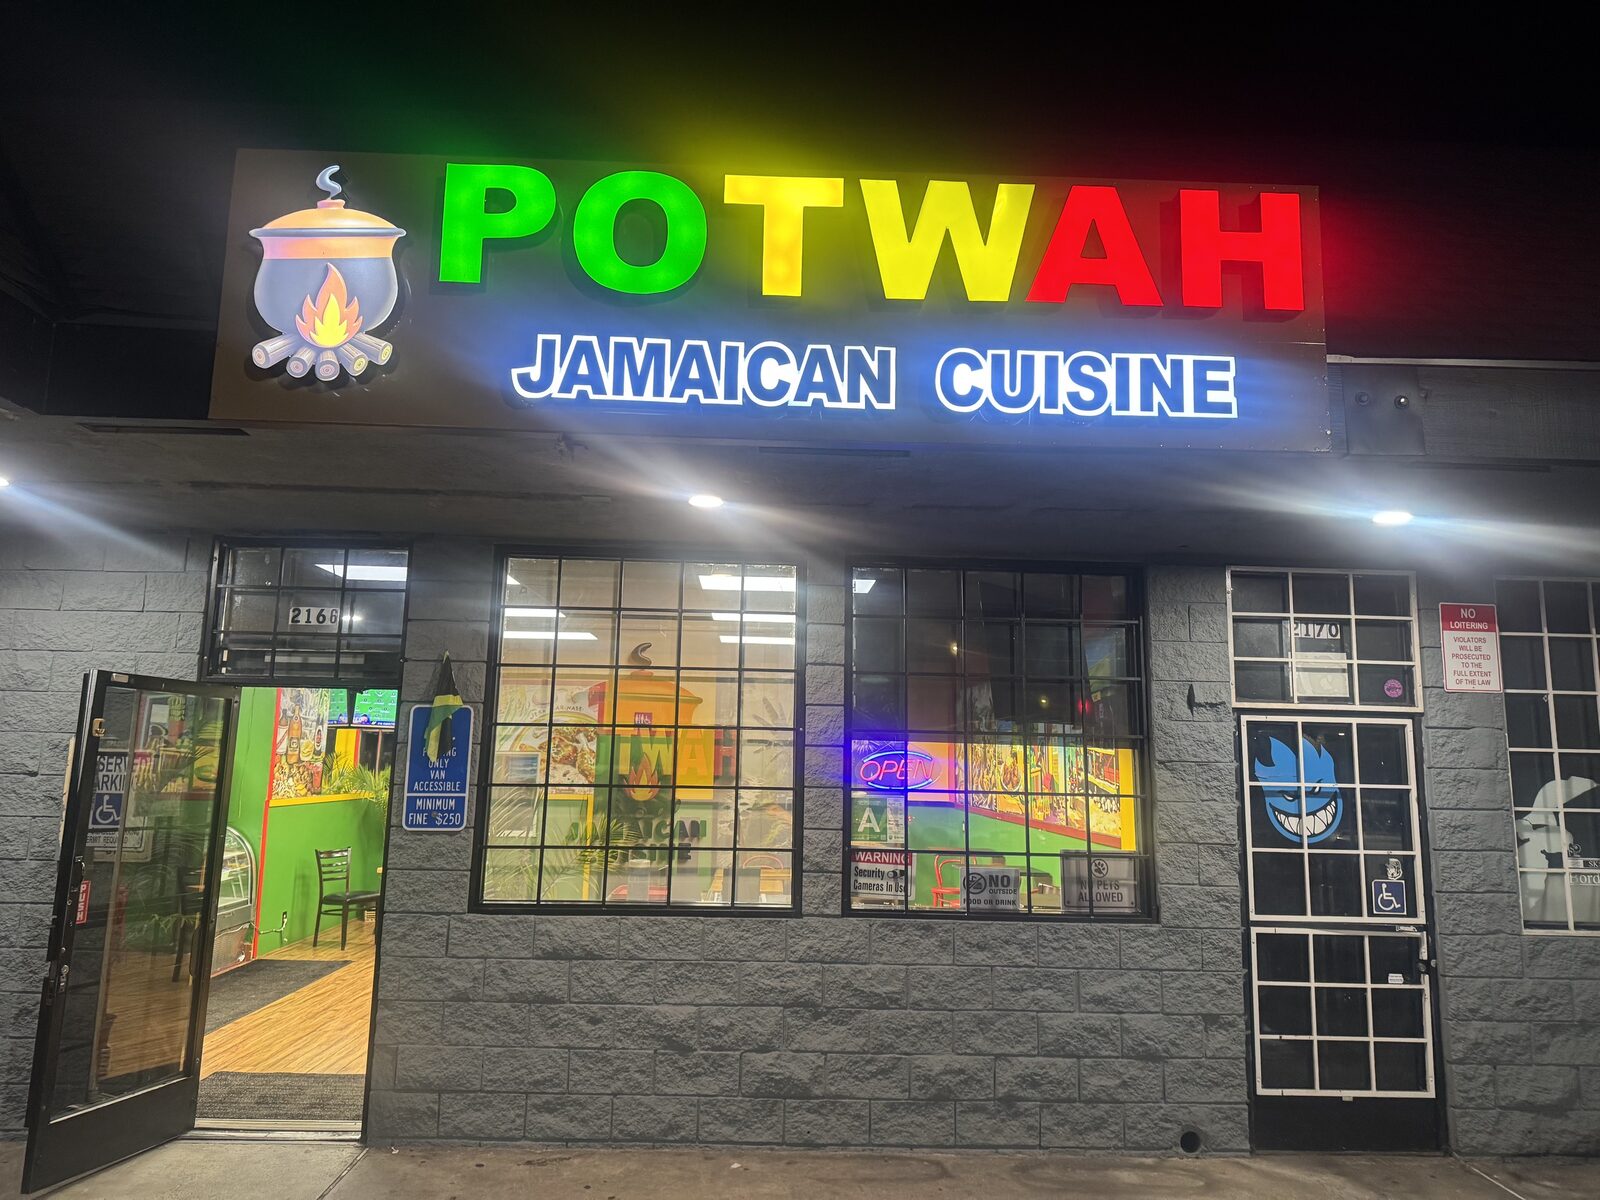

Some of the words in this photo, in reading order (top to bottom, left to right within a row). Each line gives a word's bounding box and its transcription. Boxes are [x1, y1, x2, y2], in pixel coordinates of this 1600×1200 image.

[437, 163, 1305, 312] POTWAH
[510, 333, 897, 412] JAMAICAN
[935, 347, 1239, 420] CUISINE
[1460, 608, 1476, 619] NO
[1294, 621, 1339, 638] 2170
[1449, 621, 1488, 630] LOITERING
[1453, 636, 1487, 644] VIOLATORS
[1451, 653, 1491, 661] PROSECUTED
[1469, 670, 1492, 678] EXTENT
[97, 755, 152, 774] SERVED
[428, 758, 450, 769] ONLY
[860, 759, 936, 781] OPEN
[430, 770, 446, 780] VAN
[413, 781, 461, 792] ACCESSIBLE
[415, 798, 455, 811] MINIMUM
[408, 812, 428, 825] FINE
[435, 812, 461, 826] $250
[857, 807, 881, 833] A
[855, 851, 910, 864] WARNING
[854, 866, 885, 880] Security
[853, 879, 884, 892] Cameras
[886, 881, 893, 892] In
[895, 882, 907, 893] Us
[988, 874, 1010, 888] NO
[1096, 880, 1120, 891] PETS
[76, 884, 87, 921] PUSH
[1078, 892, 1123, 903] ALOWED
